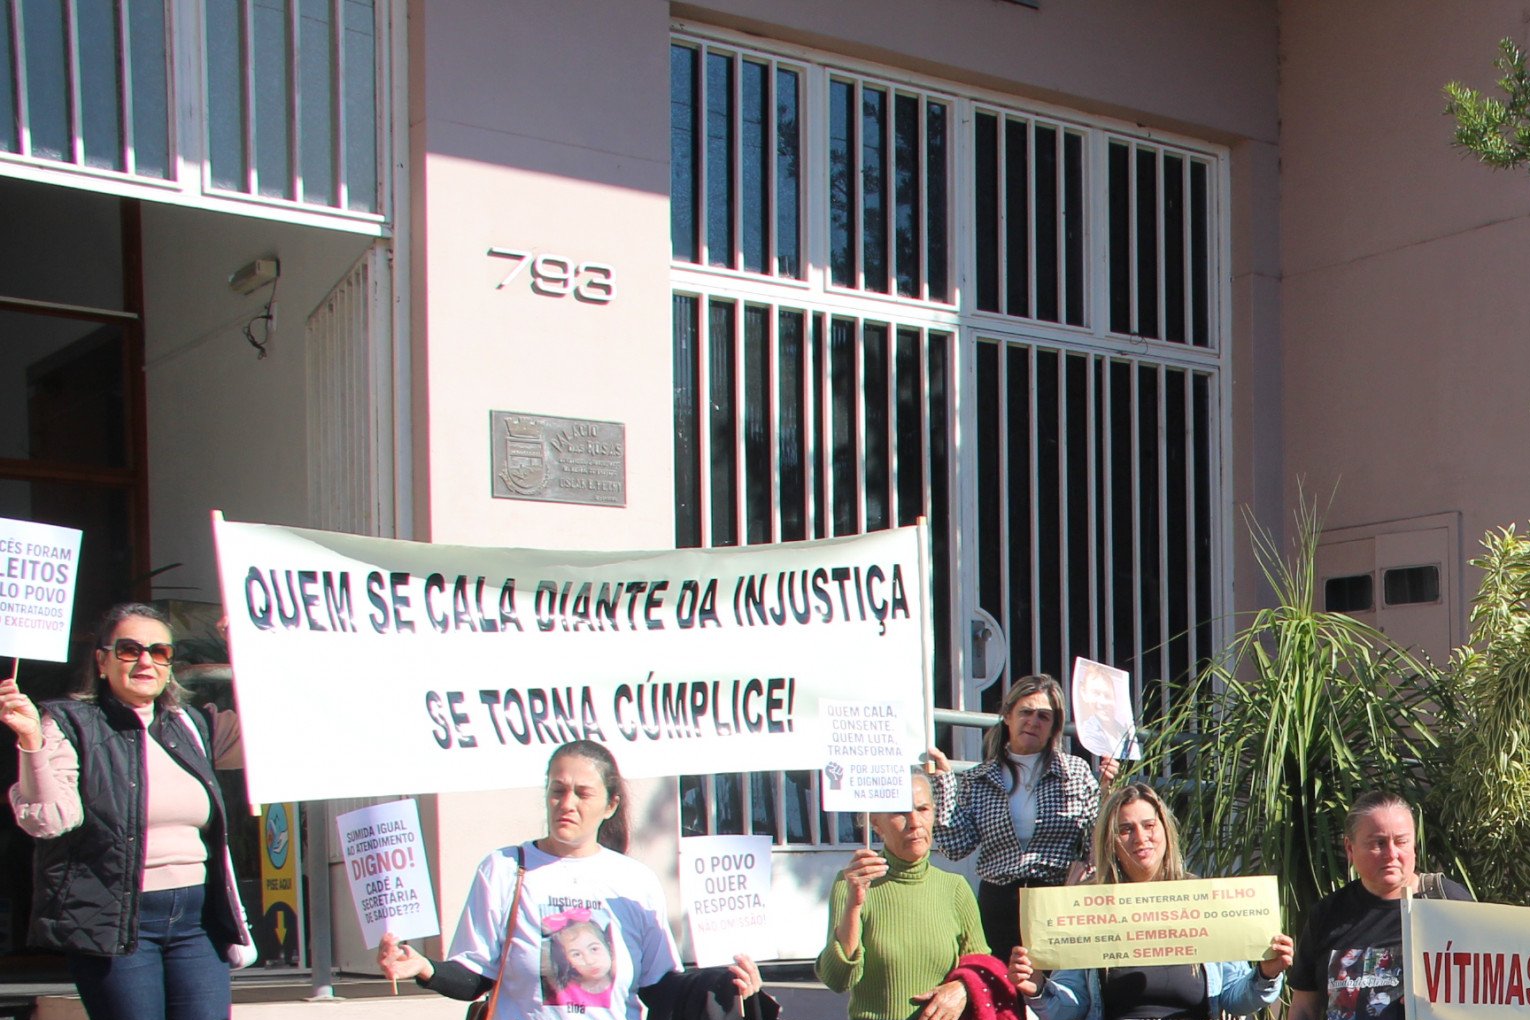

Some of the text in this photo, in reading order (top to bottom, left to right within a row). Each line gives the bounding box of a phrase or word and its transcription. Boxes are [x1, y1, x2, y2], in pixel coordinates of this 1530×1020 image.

[487, 247, 617, 305] 793
[0, 537, 72, 561] CÊS FORAM
[0, 581, 66, 604] LO POVO
[245, 564, 910, 636] QUEM SE CALA DIANTE DA INJUSTIÇA
[0, 601, 63, 618] ONTRATADOS
[4, 616, 65, 632] EXECUTIVO?
[426, 671, 795, 749] SE TORNA CÚMPLICE!
[827, 705, 897, 719] QUEM CALA,
[832, 732, 864, 744] QUEM
[850, 764, 867, 774] POR
[850, 775, 903, 787] E DIGNIDADE
[854, 789, 866, 799] NA
[346, 820, 407, 844] SUMIDA IGUAL
[356, 832, 415, 854] ATENDIMENTO
[351, 847, 416, 881] DIGNO!
[694, 853, 755, 875] O POVO
[366, 876, 404, 896] CADÊ A
[705, 874, 747, 895] QUER
[1084, 895, 1116, 907] DOR
[1119, 897, 1132, 905] DE
[1135, 893, 1189, 904] ENTERRAR
[1193, 893, 1209, 901] UM
[1212, 888, 1256, 900] FILHO
[365, 912, 374, 925] DE
[1131, 908, 1201, 923] OMISSÃO
[1204, 911, 1218, 919] DO
[1221, 908, 1270, 918] GOVERNO
[1126, 927, 1209, 941] LEMBRADA
[1103, 945, 1197, 960] PARA SEMPRE!
